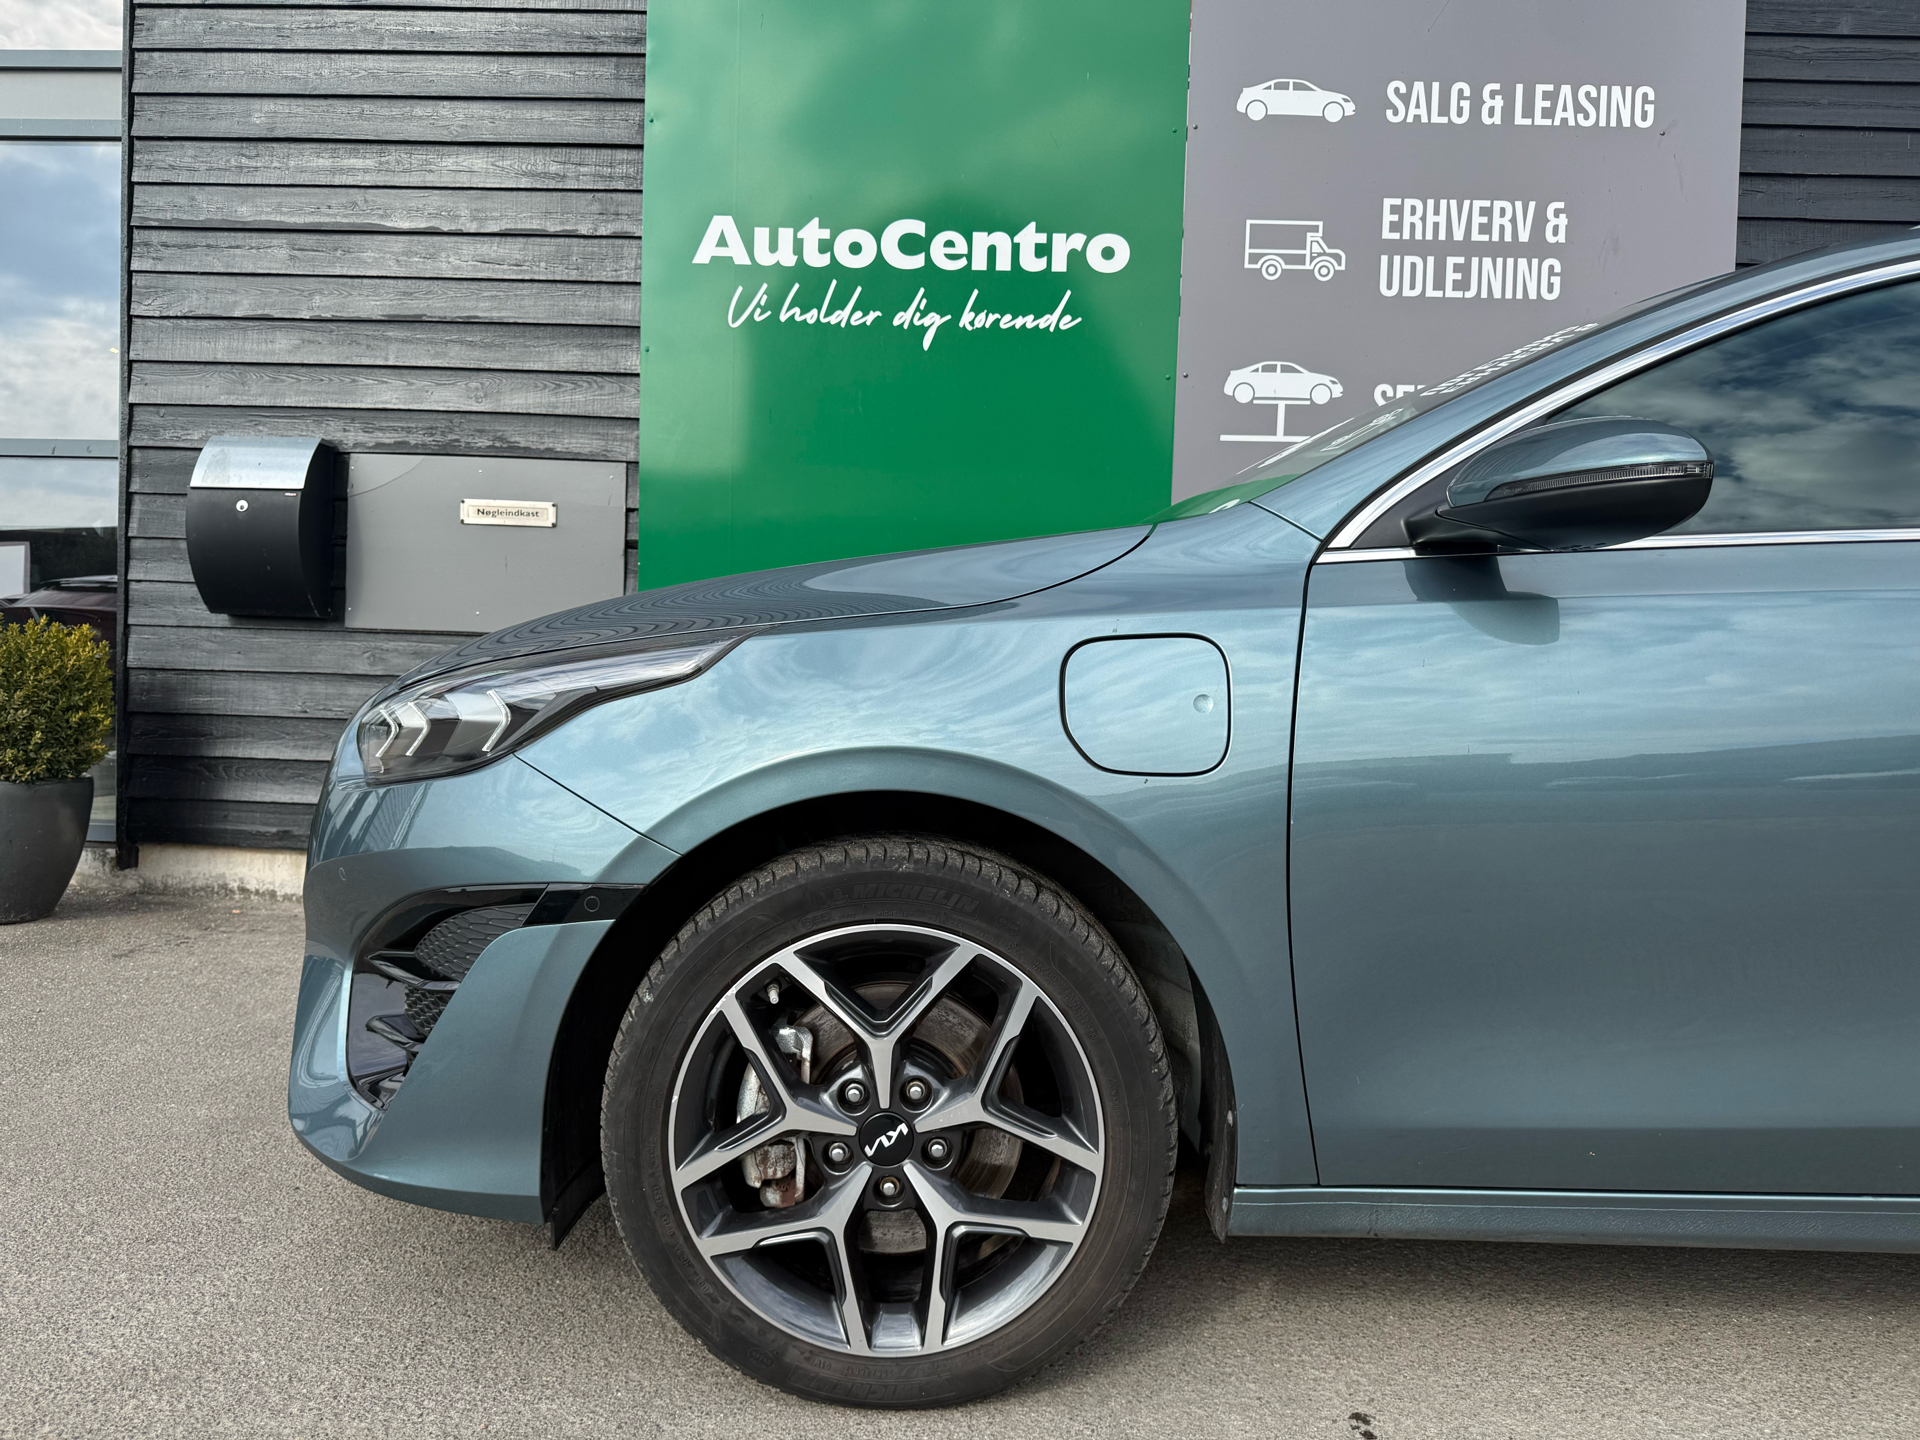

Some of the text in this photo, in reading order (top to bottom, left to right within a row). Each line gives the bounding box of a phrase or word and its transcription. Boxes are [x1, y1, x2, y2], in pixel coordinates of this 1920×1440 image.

[1385, 80, 1656, 129] SALG & LEASING
[691, 214, 1131, 274] AutoCentro
[1381, 197, 1568, 244] ERHVERV &
[1379, 254, 1562, 301] UDLEJNING
[727, 278, 1083, 352] Vi holder dig kørende
[476, 508, 540, 518] Nøgleindkast
